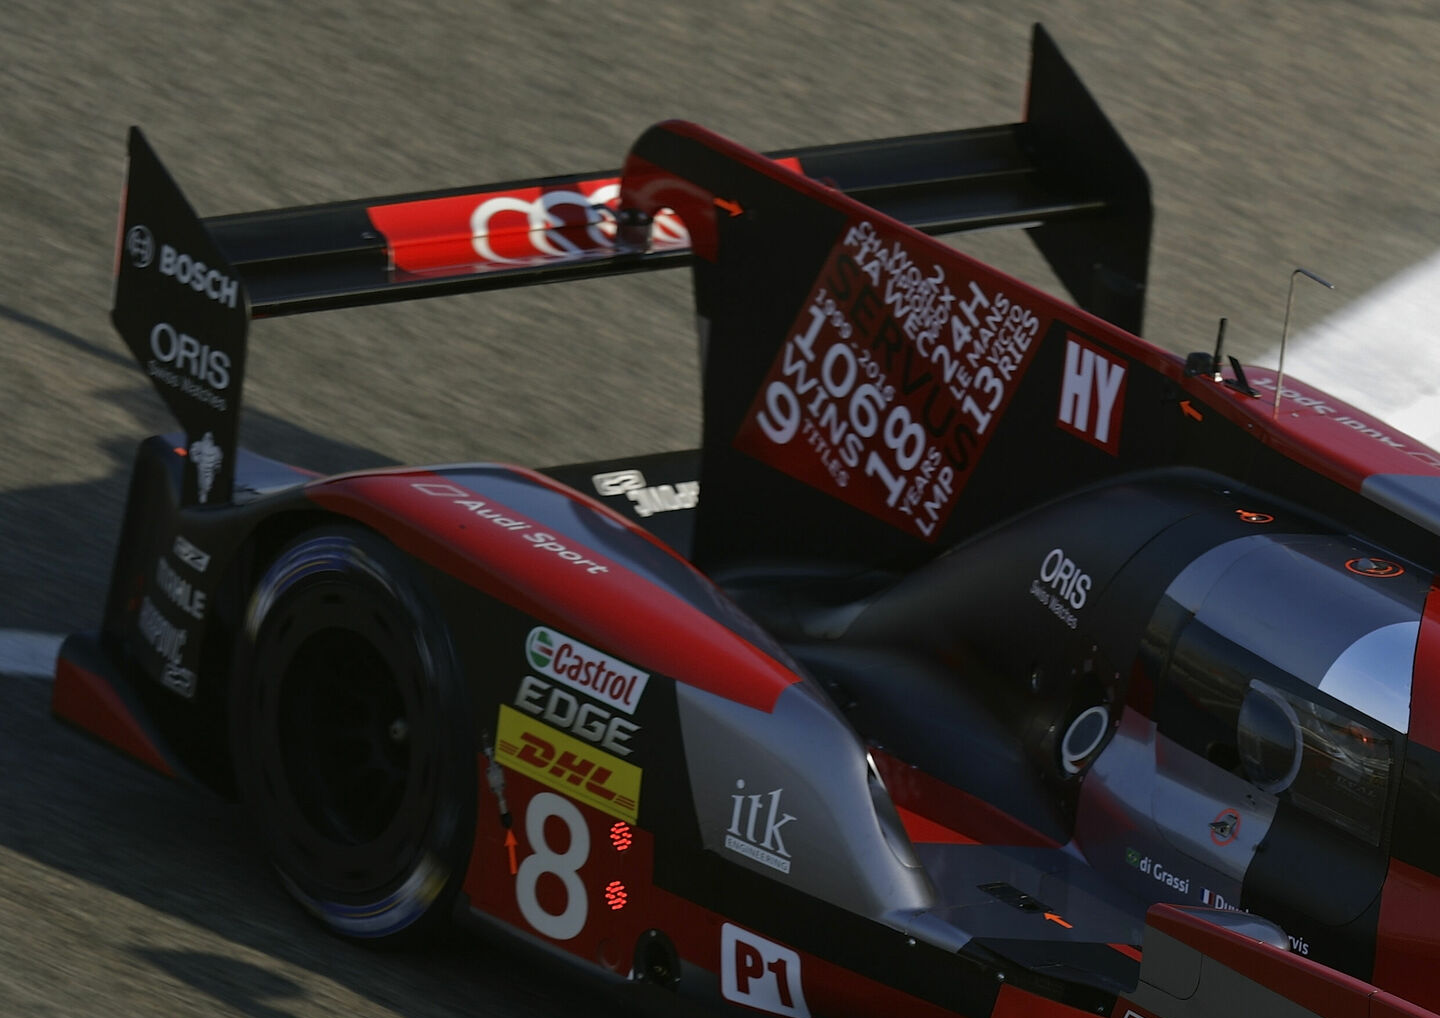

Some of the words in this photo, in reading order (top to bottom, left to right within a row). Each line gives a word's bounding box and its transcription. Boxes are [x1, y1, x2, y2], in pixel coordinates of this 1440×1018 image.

[159, 244, 239, 309] BOSCH
[843, 226, 881, 287] FIA
[885, 279, 929, 357] WEC
[150, 322, 232, 390] ORIS
[828, 253, 978, 471] SERVUS
[931, 281, 990, 384] 24H
[949, 365, 973, 400] LE
[966, 292, 1010, 368] MANS
[986, 304, 1024, 364] VICTO
[998, 310, 1039, 381] RIES
[783, 341, 864, 468] WINS
[961, 365, 1005, 434] 13
[1059, 340, 1126, 443] HY
[865, 405, 926, 507] 18
[898, 446, 942, 515] YEARS
[915, 465, 954, 536] LMP
[454, 498, 532, 532] Audi
[523, 531, 609, 575] Sport
[1040, 548, 1092, 609] ORIS
[552, 641, 639, 707] Castrol
[514, 675, 642, 756] EDGE
[516, 732, 617, 803] DHL
[727, 778, 797, 858] itk
[515, 791, 590, 941] 8
[1139, 856, 1152, 875] di
[1153, 863, 1189, 894] Grassi
[734, 939, 795, 1009] P1
